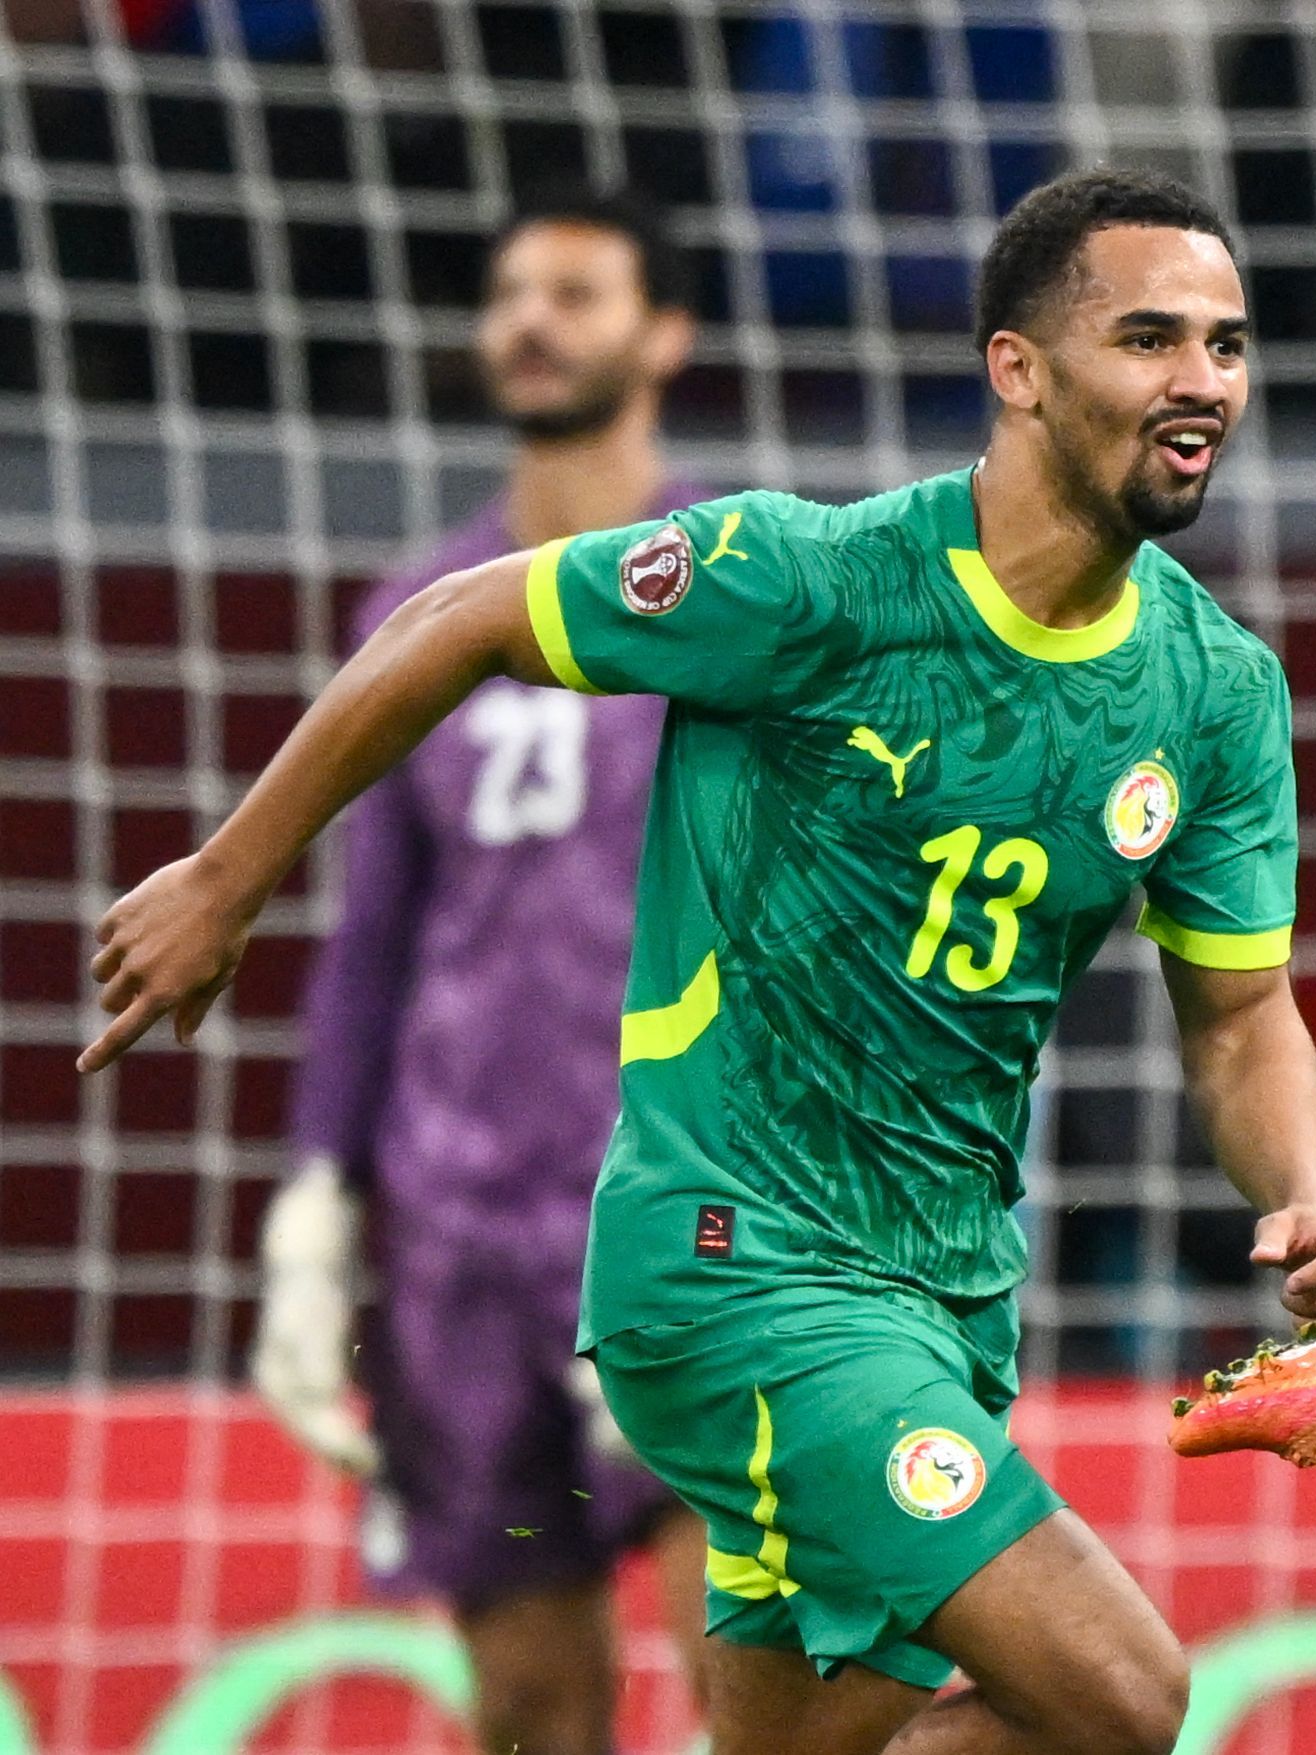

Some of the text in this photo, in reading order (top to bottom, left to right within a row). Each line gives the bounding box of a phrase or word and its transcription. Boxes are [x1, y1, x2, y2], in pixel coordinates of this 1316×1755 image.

[674, 560, 688, 593] AFRICA
[647, 601, 661, 611] OF
[661, 592, 677, 607] CUP
[466, 686, 588, 847] 23
[906, 824, 1049, 992] 13
